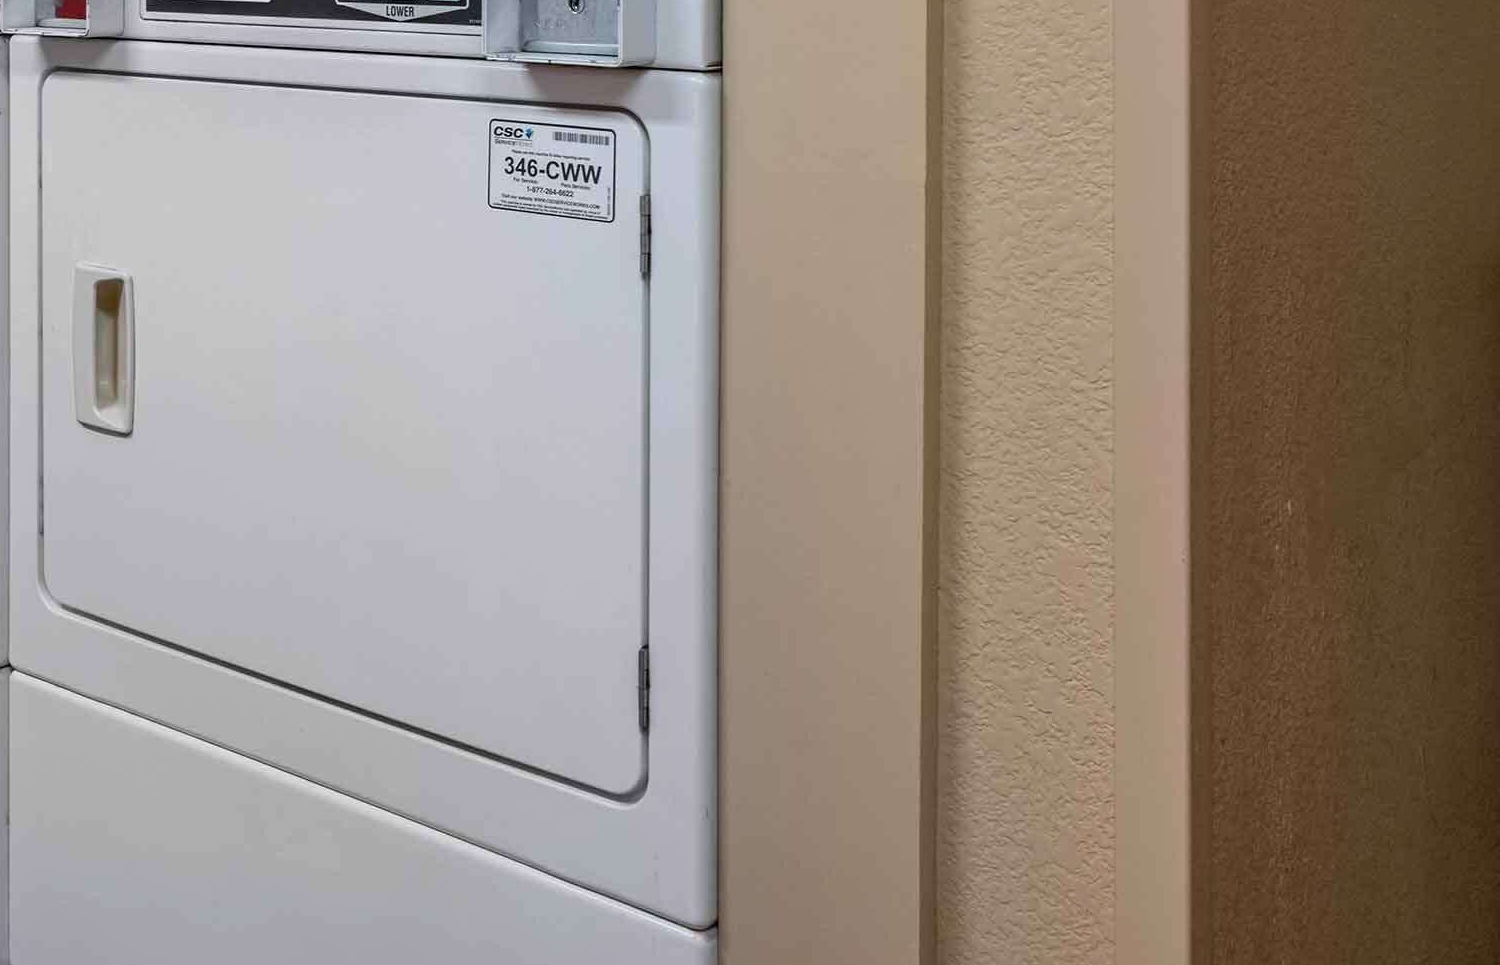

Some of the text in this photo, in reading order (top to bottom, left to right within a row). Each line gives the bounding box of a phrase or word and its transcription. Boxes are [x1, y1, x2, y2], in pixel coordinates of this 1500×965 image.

[386, 6, 414, 17] LOWER
[494, 126, 523, 138] CSC
[504, 156, 602, 184] 346-CWW
